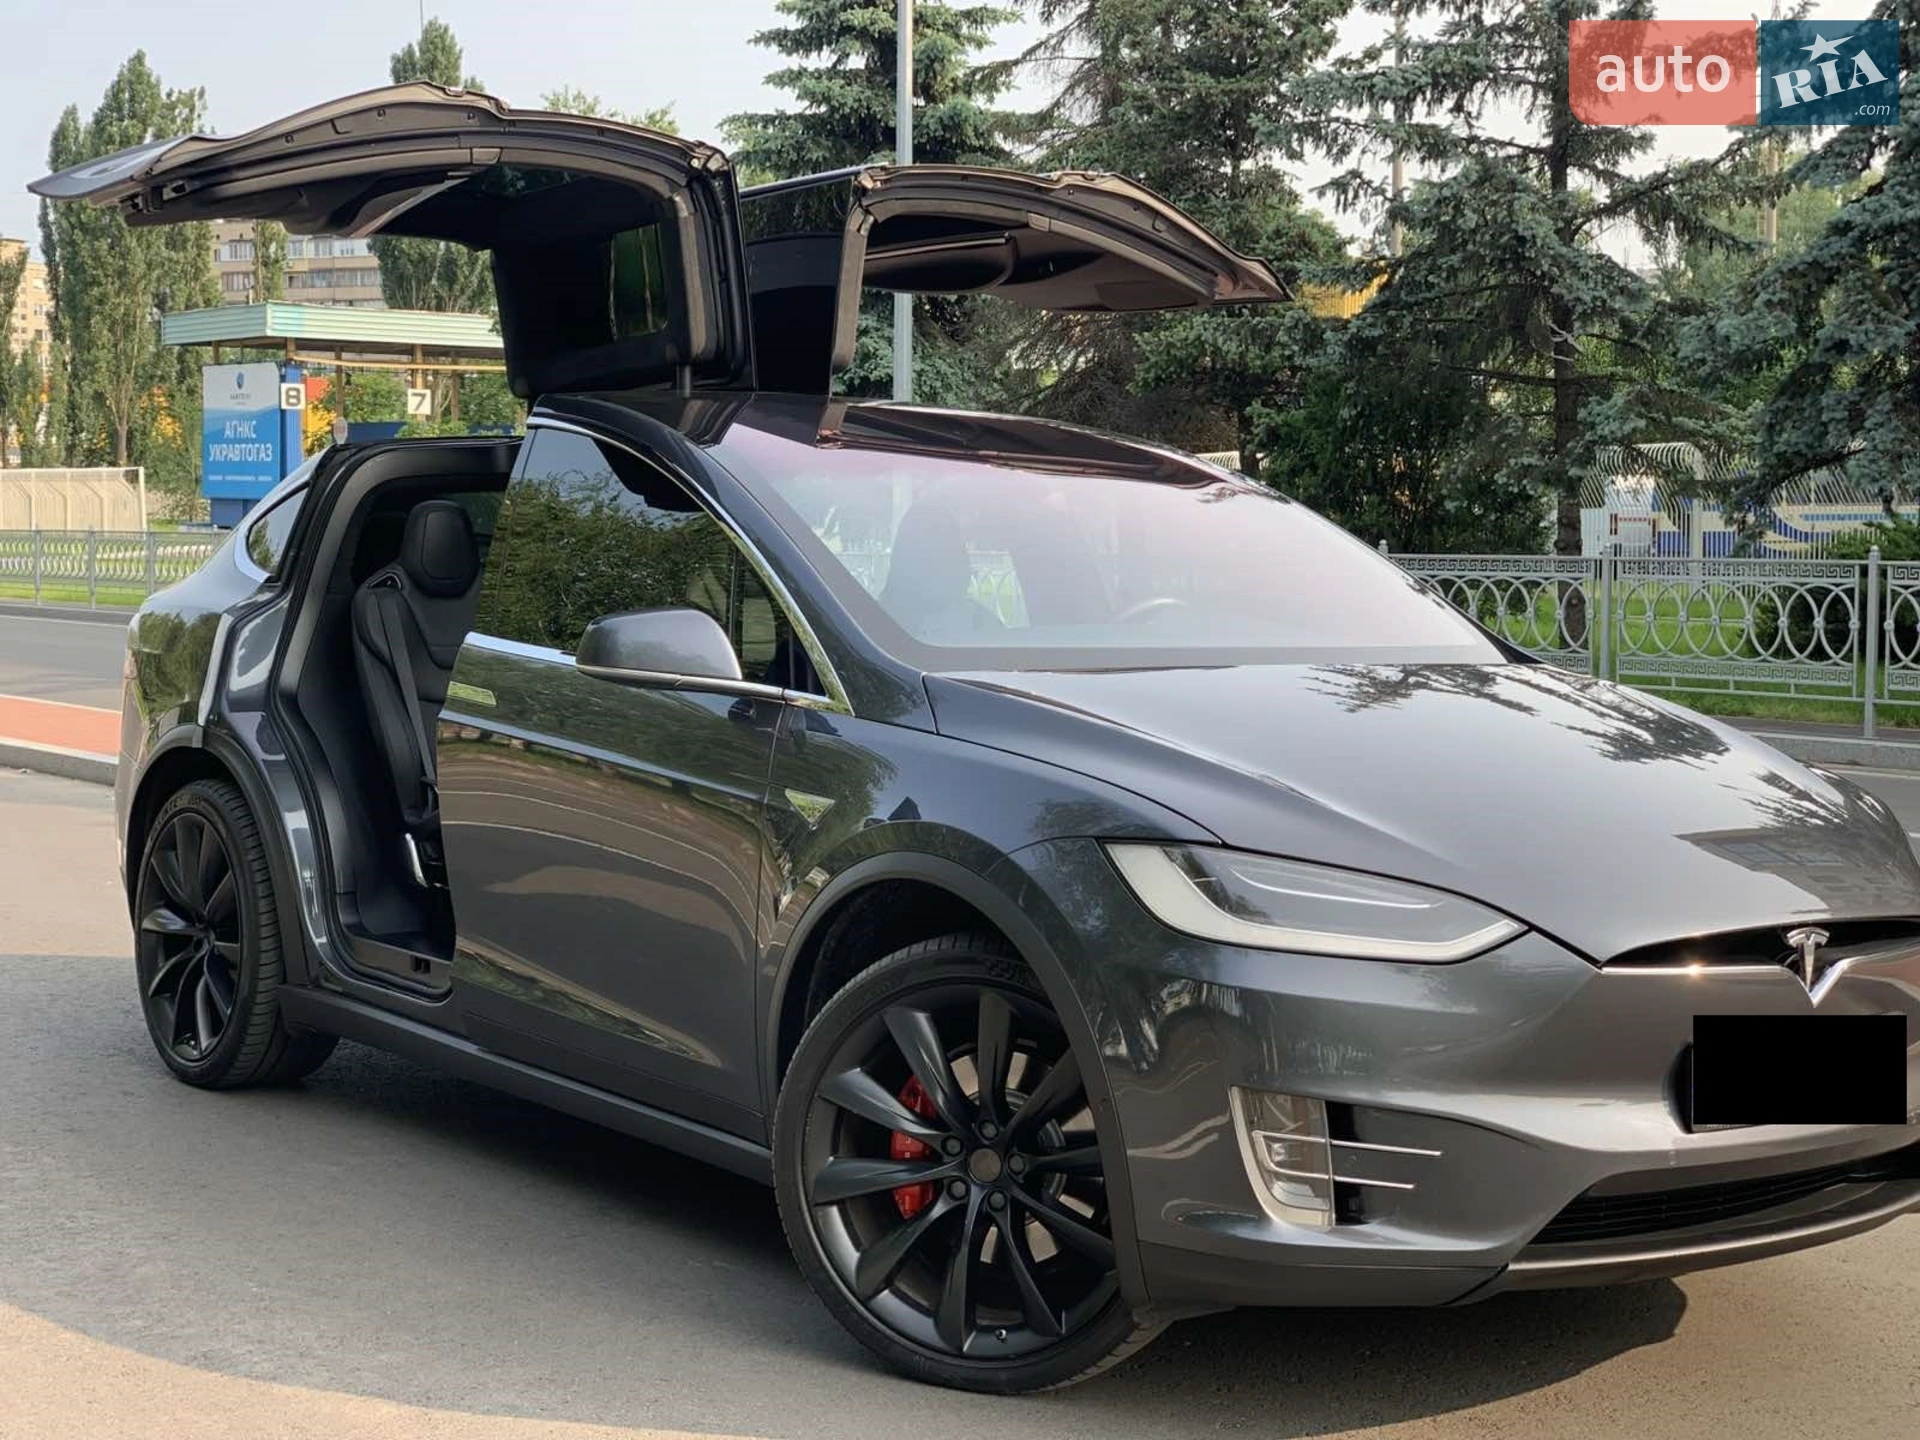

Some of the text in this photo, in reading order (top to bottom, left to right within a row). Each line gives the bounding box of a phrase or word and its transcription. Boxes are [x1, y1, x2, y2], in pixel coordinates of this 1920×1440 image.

[284, 387, 301, 407] 8
[411, 392, 427, 411] 7
[224, 420, 257, 439] АГНКС
[209, 444, 272, 462] УКРАВТОГАЗ
